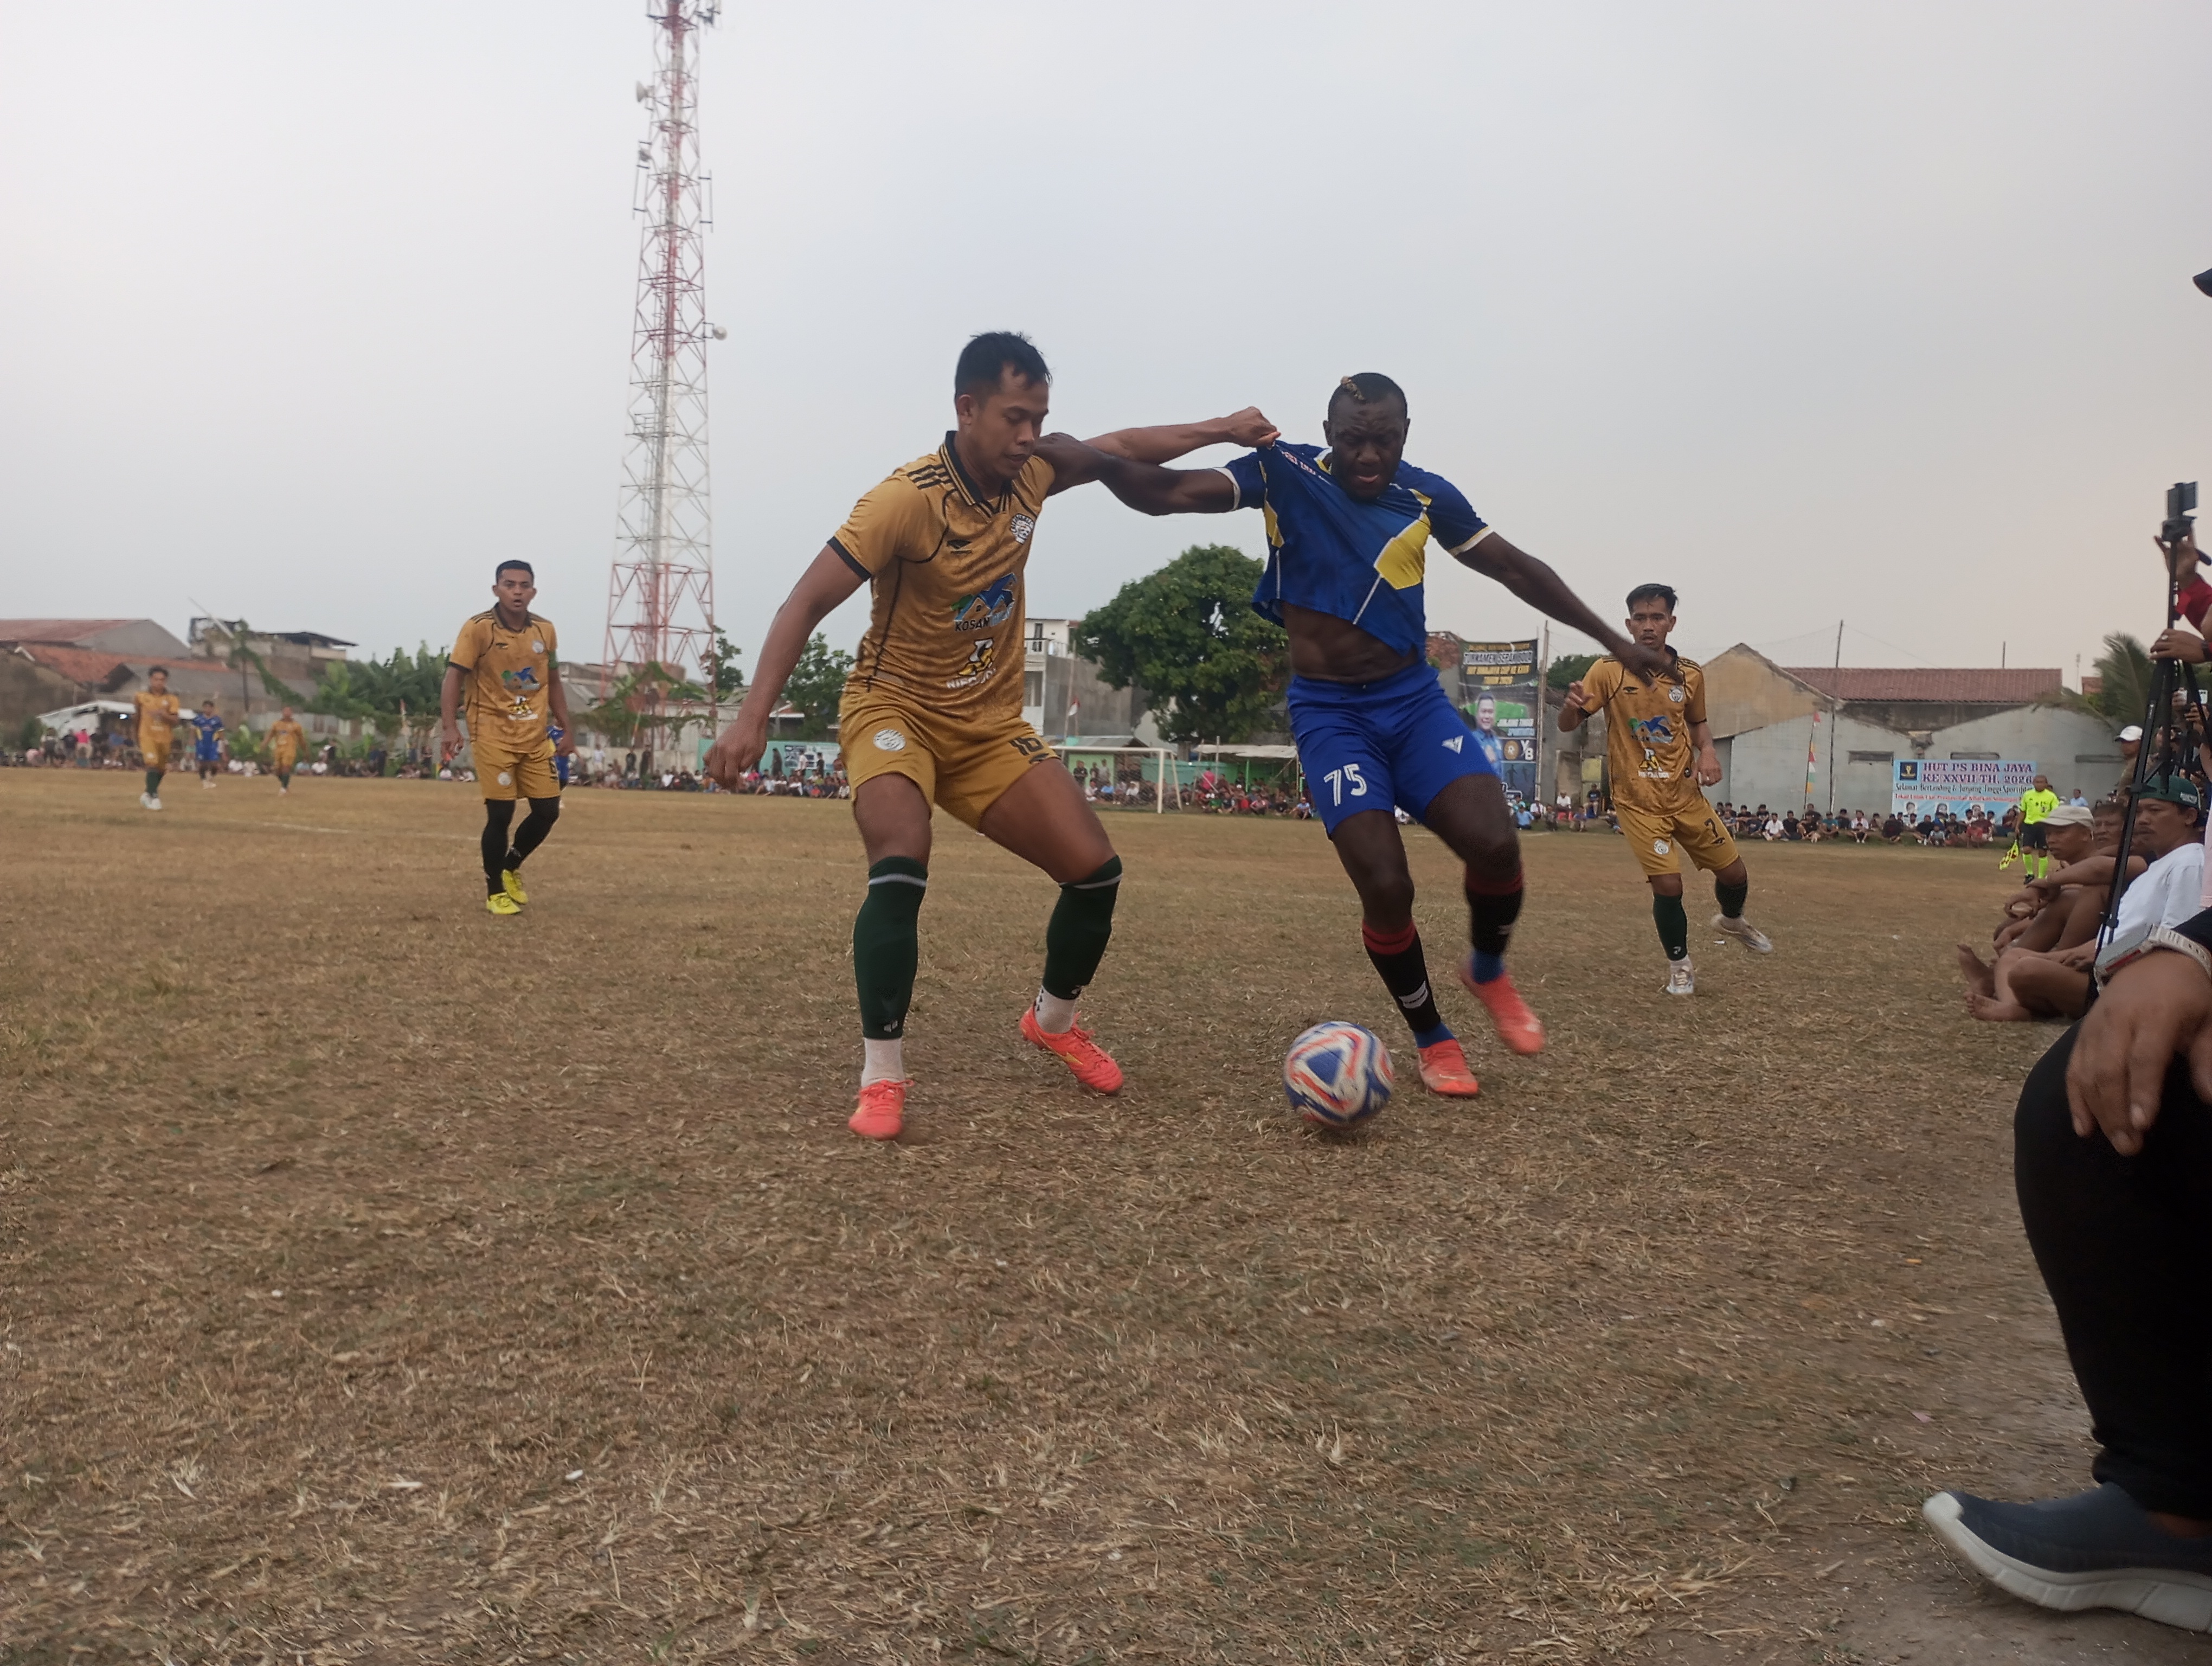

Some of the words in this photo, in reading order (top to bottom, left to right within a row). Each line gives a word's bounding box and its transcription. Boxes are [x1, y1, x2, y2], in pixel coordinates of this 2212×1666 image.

[955, 617, 990, 631] KOSAN
[1924, 762, 1949, 771] HUT
[1952, 763, 1967, 772] PS
[1971, 763, 2000, 772] BINA
[2004, 764, 2033, 773] JAYA
[1922, 773, 1939, 782] KE
